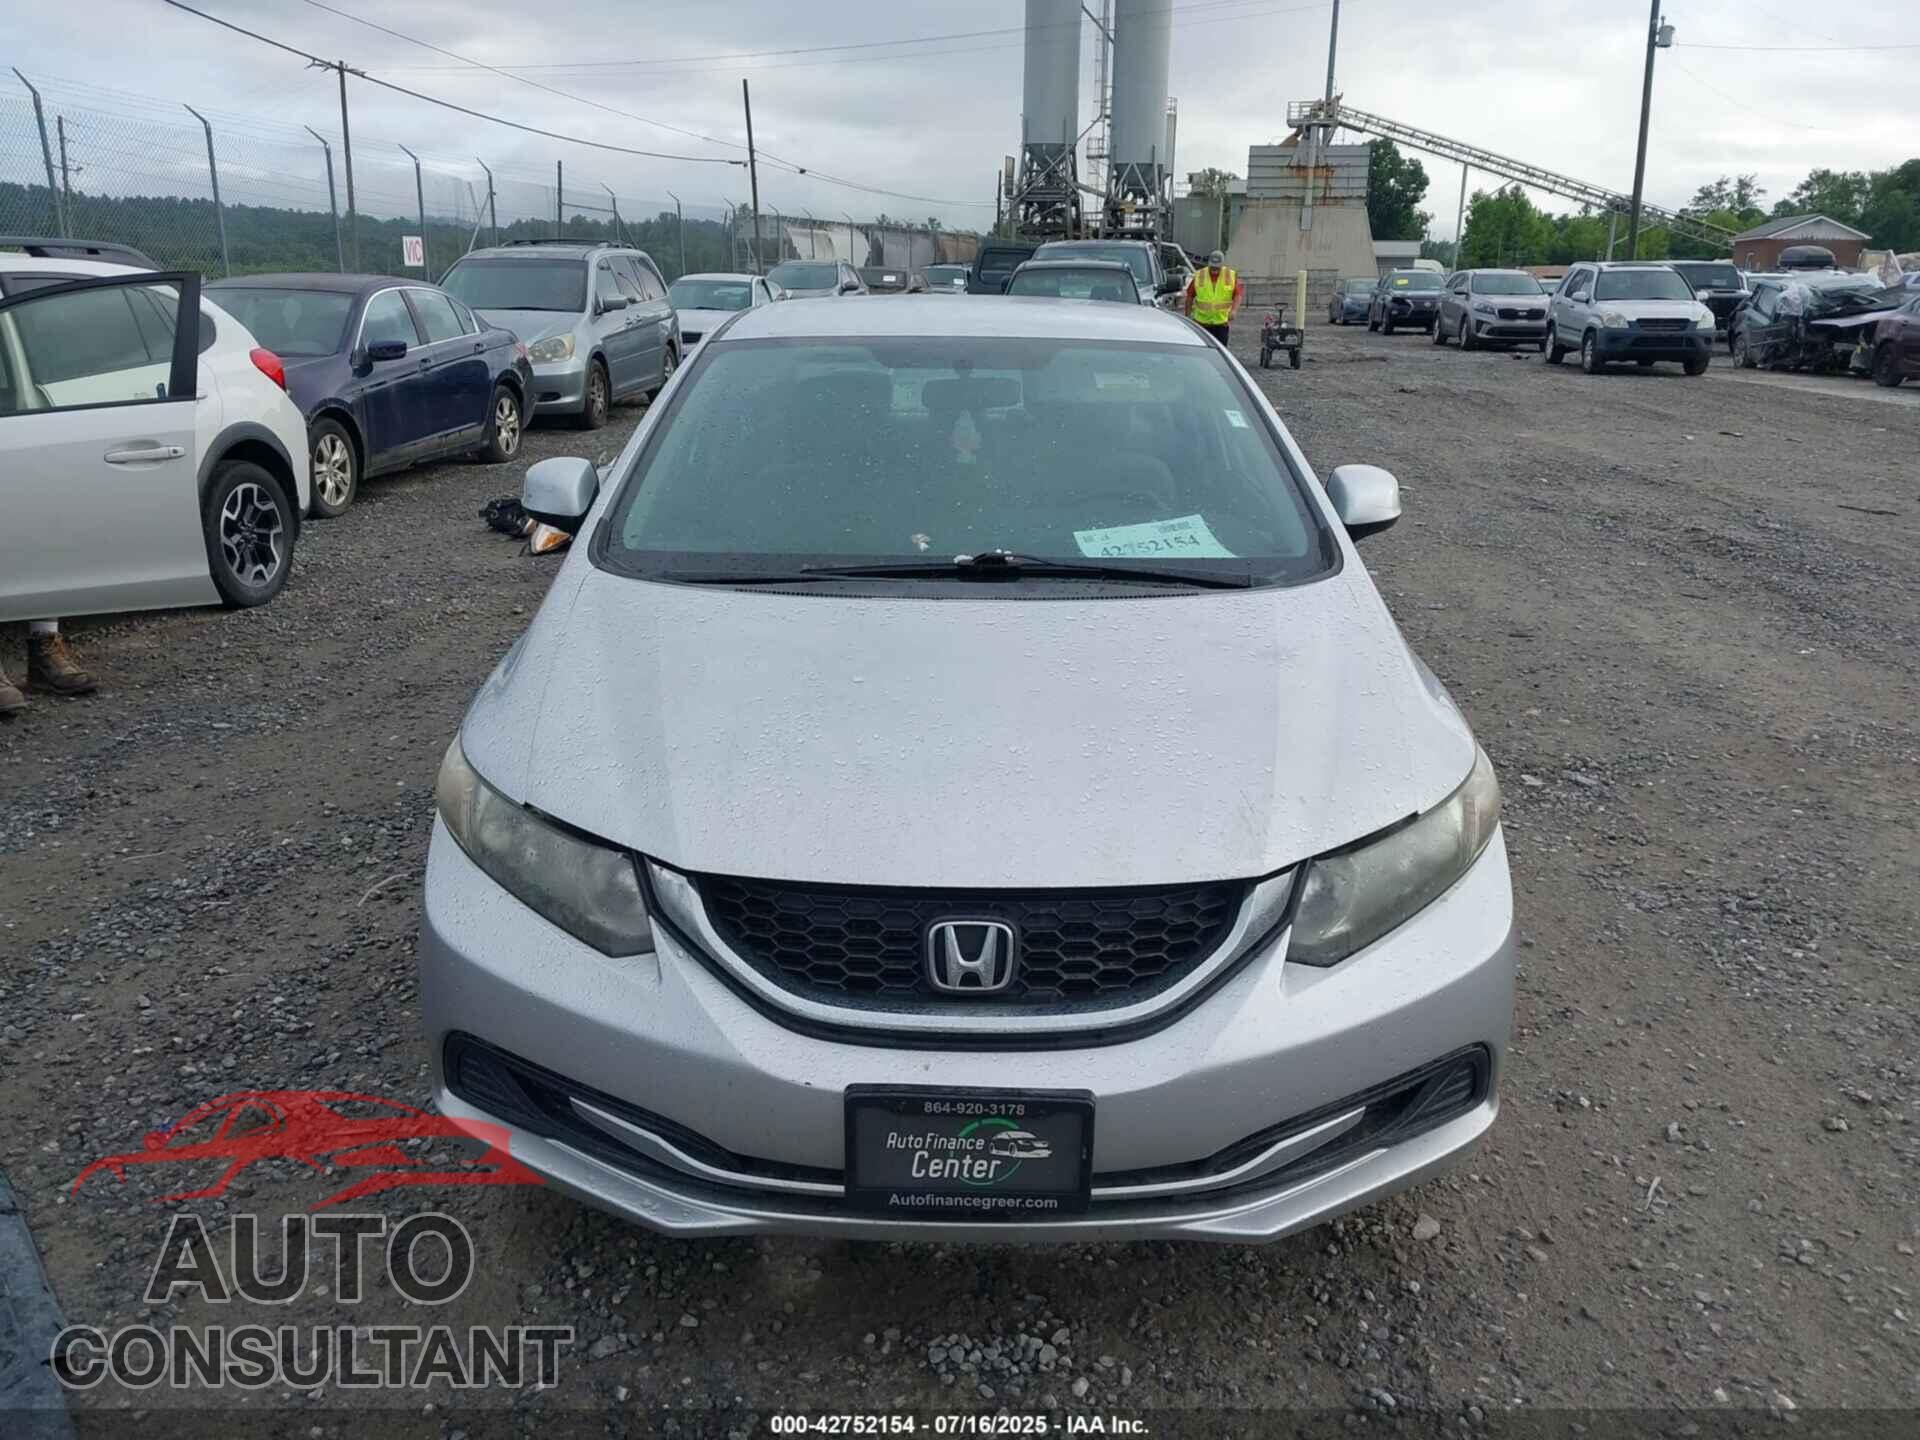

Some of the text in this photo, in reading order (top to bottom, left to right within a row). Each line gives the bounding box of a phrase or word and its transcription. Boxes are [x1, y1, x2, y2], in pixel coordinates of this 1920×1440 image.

[924, 1101, 1025, 1116] 864-920-3178
[911, 1151, 1001, 1178] Center
[889, 1193, 1058, 1209] Autofinancegreer.com
